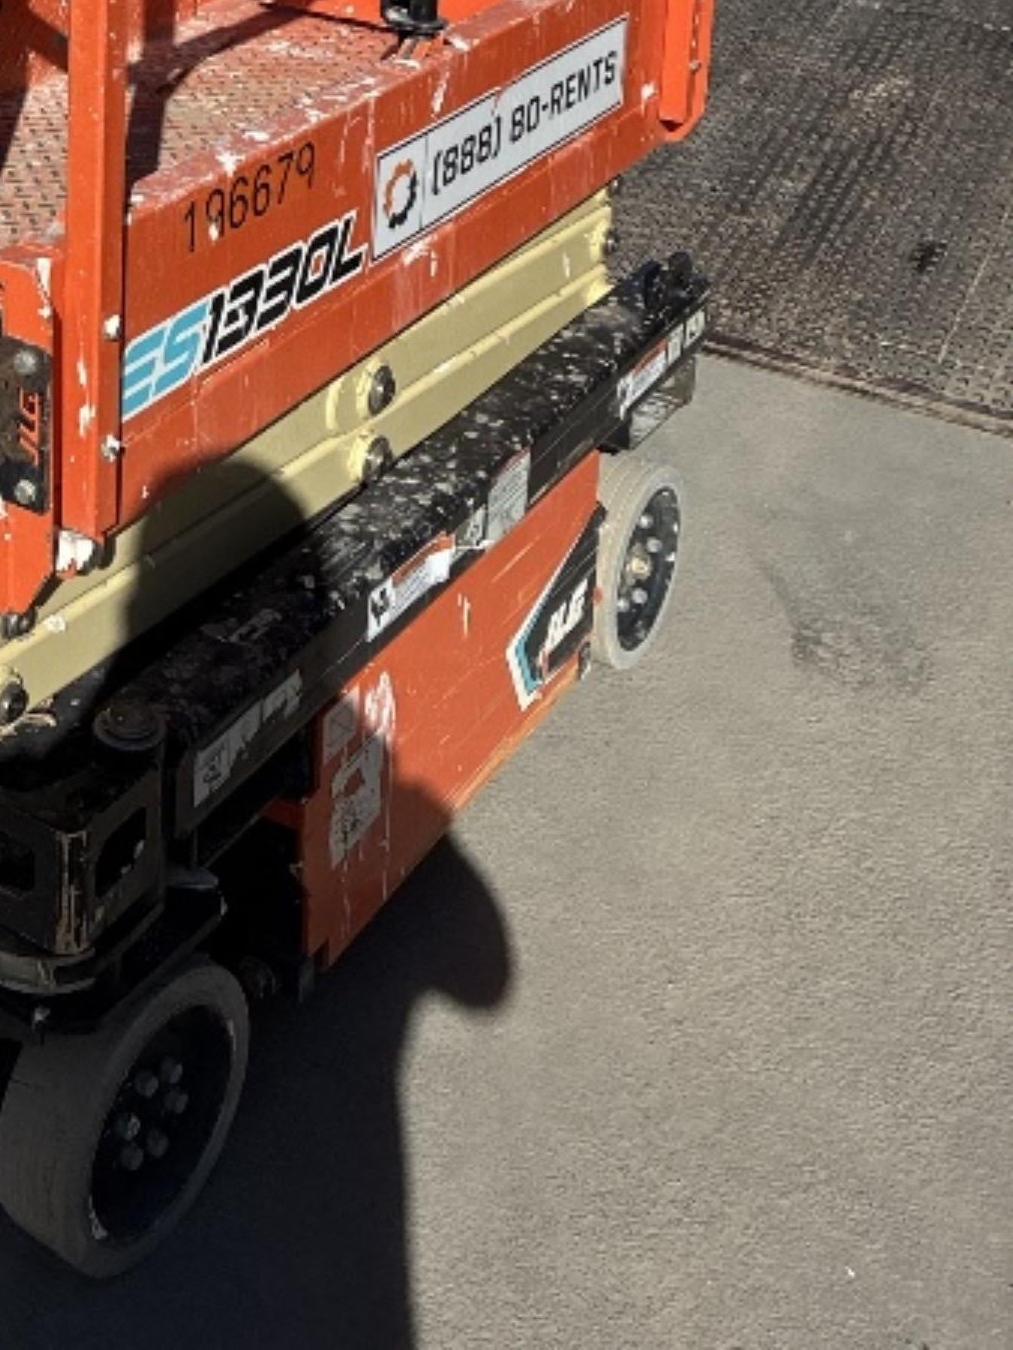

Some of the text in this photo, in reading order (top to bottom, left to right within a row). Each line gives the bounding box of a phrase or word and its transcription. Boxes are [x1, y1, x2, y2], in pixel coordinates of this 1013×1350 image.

[184, 141, 316, 252] 196679
[431, 115, 502, 196] (888)
[122, 208, 368, 422] ES1330L
